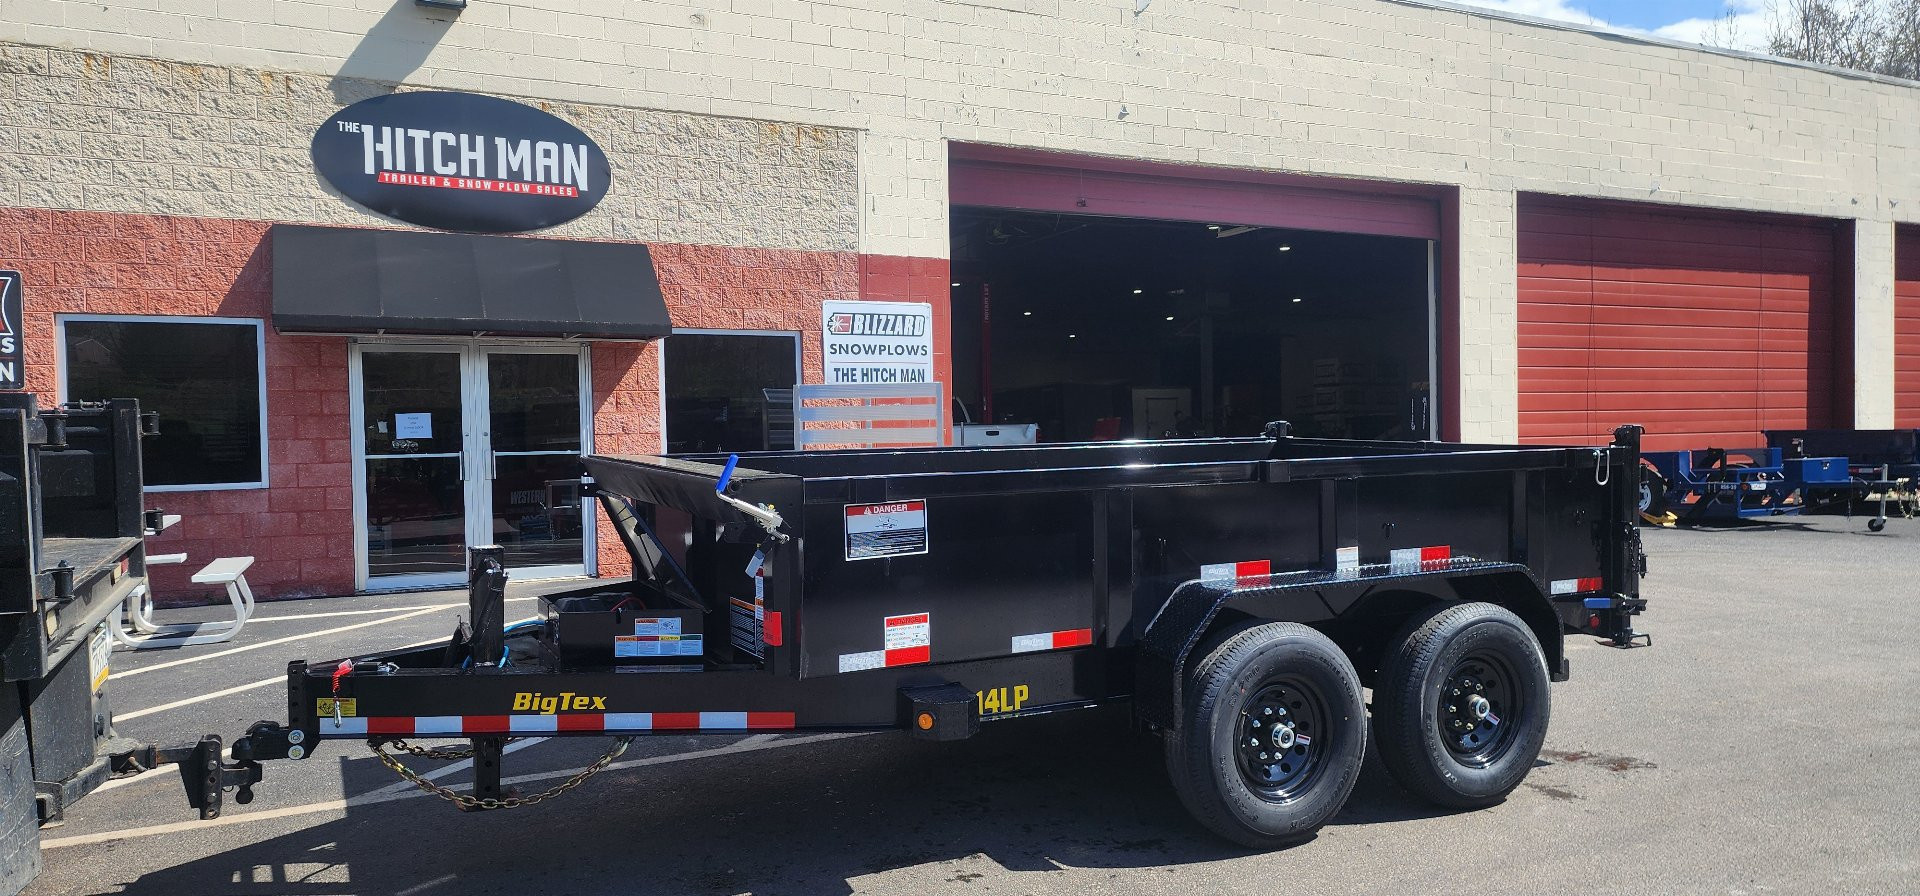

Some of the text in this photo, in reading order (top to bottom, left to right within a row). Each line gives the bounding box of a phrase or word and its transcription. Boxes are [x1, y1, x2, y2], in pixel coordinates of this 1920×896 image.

[337, 120, 360, 133] THE
[361, 124, 588, 191] HITCH MAN
[383, 172, 573, 196] TRAILER & SNOW PLOW SALES
[854, 314, 924, 336] BLIZZARD
[829, 343, 928, 356] SNOWPLOWS
[833, 367, 925, 383] THE HITCH MAN
[510, 489, 546, 505] WESTERN
[873, 503, 908, 514] DANGER
[512, 692, 607, 715] BigTex
[976, 684, 1029, 715] 14LP
